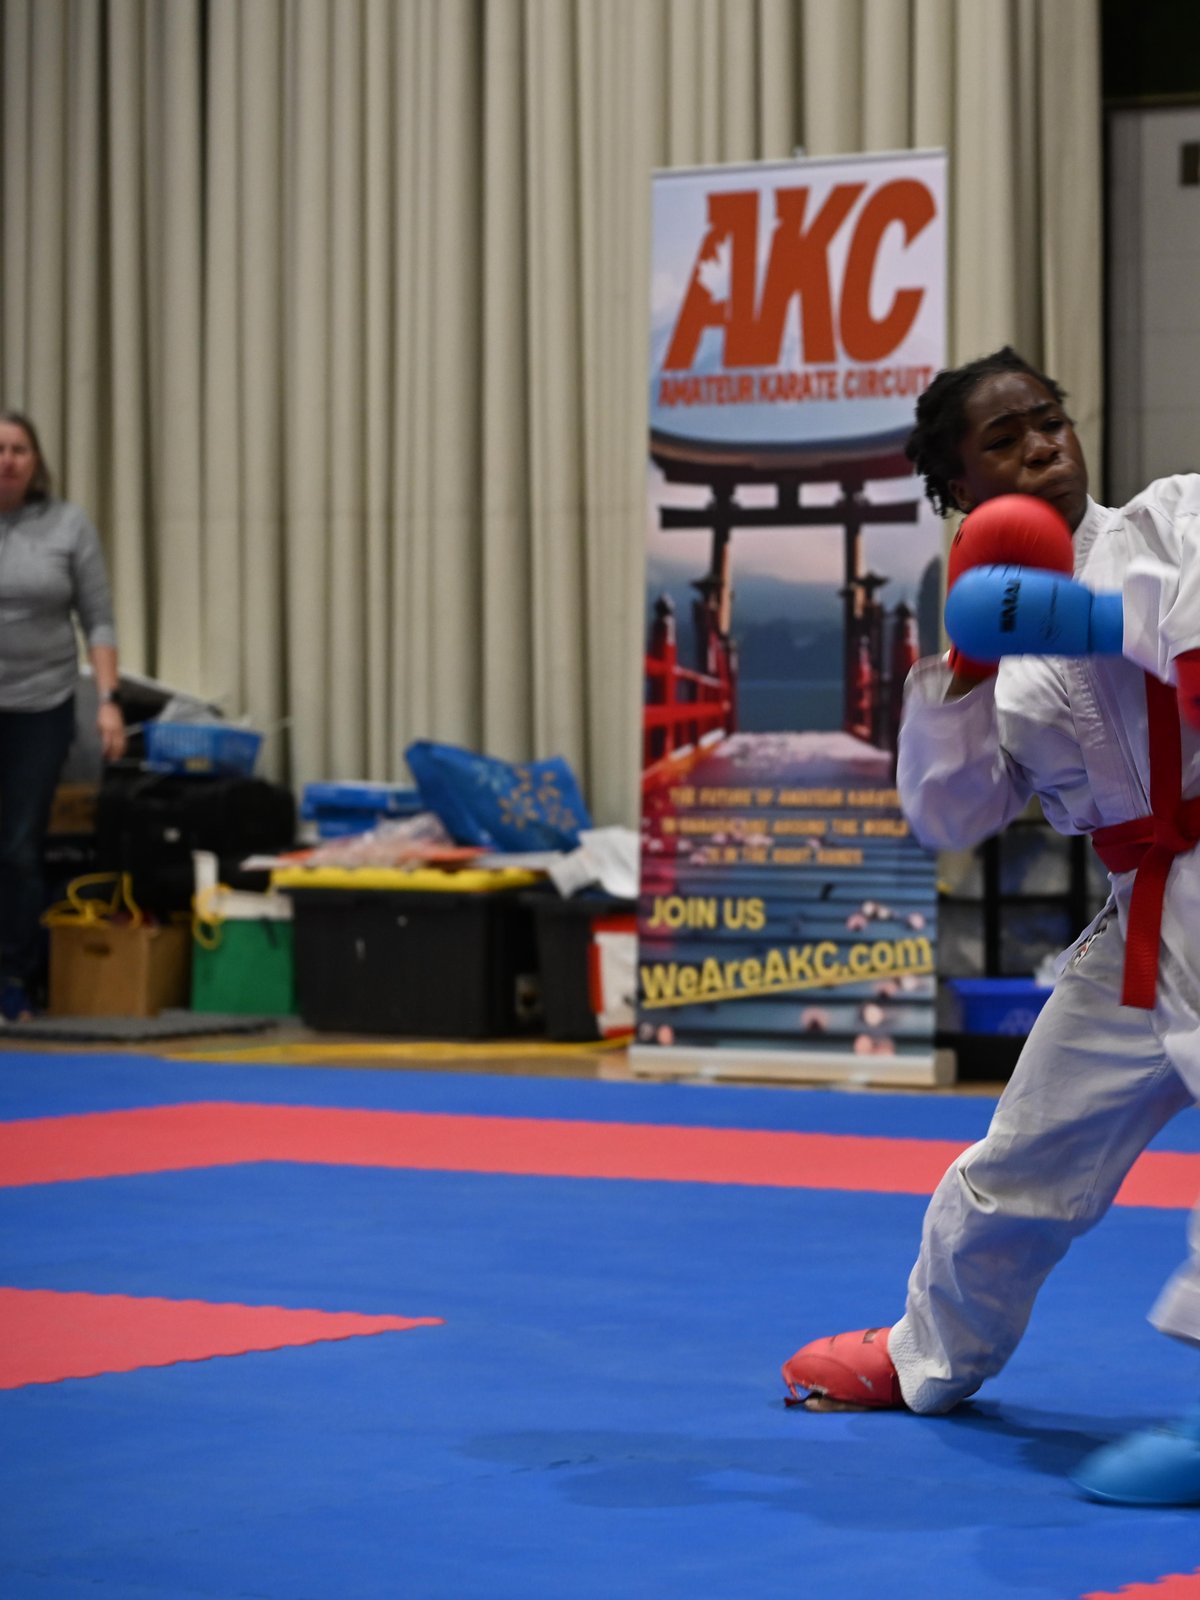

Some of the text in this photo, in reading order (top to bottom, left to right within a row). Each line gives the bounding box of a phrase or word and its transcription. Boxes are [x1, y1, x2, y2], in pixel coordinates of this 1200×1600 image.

[662, 178, 937, 371] AKC
[658, 366, 933, 408] AMATEUR KARATE CIRCUIT
[648, 896, 766, 929] JOIN US
[642, 937, 933, 1002] WeAreAKC.com
